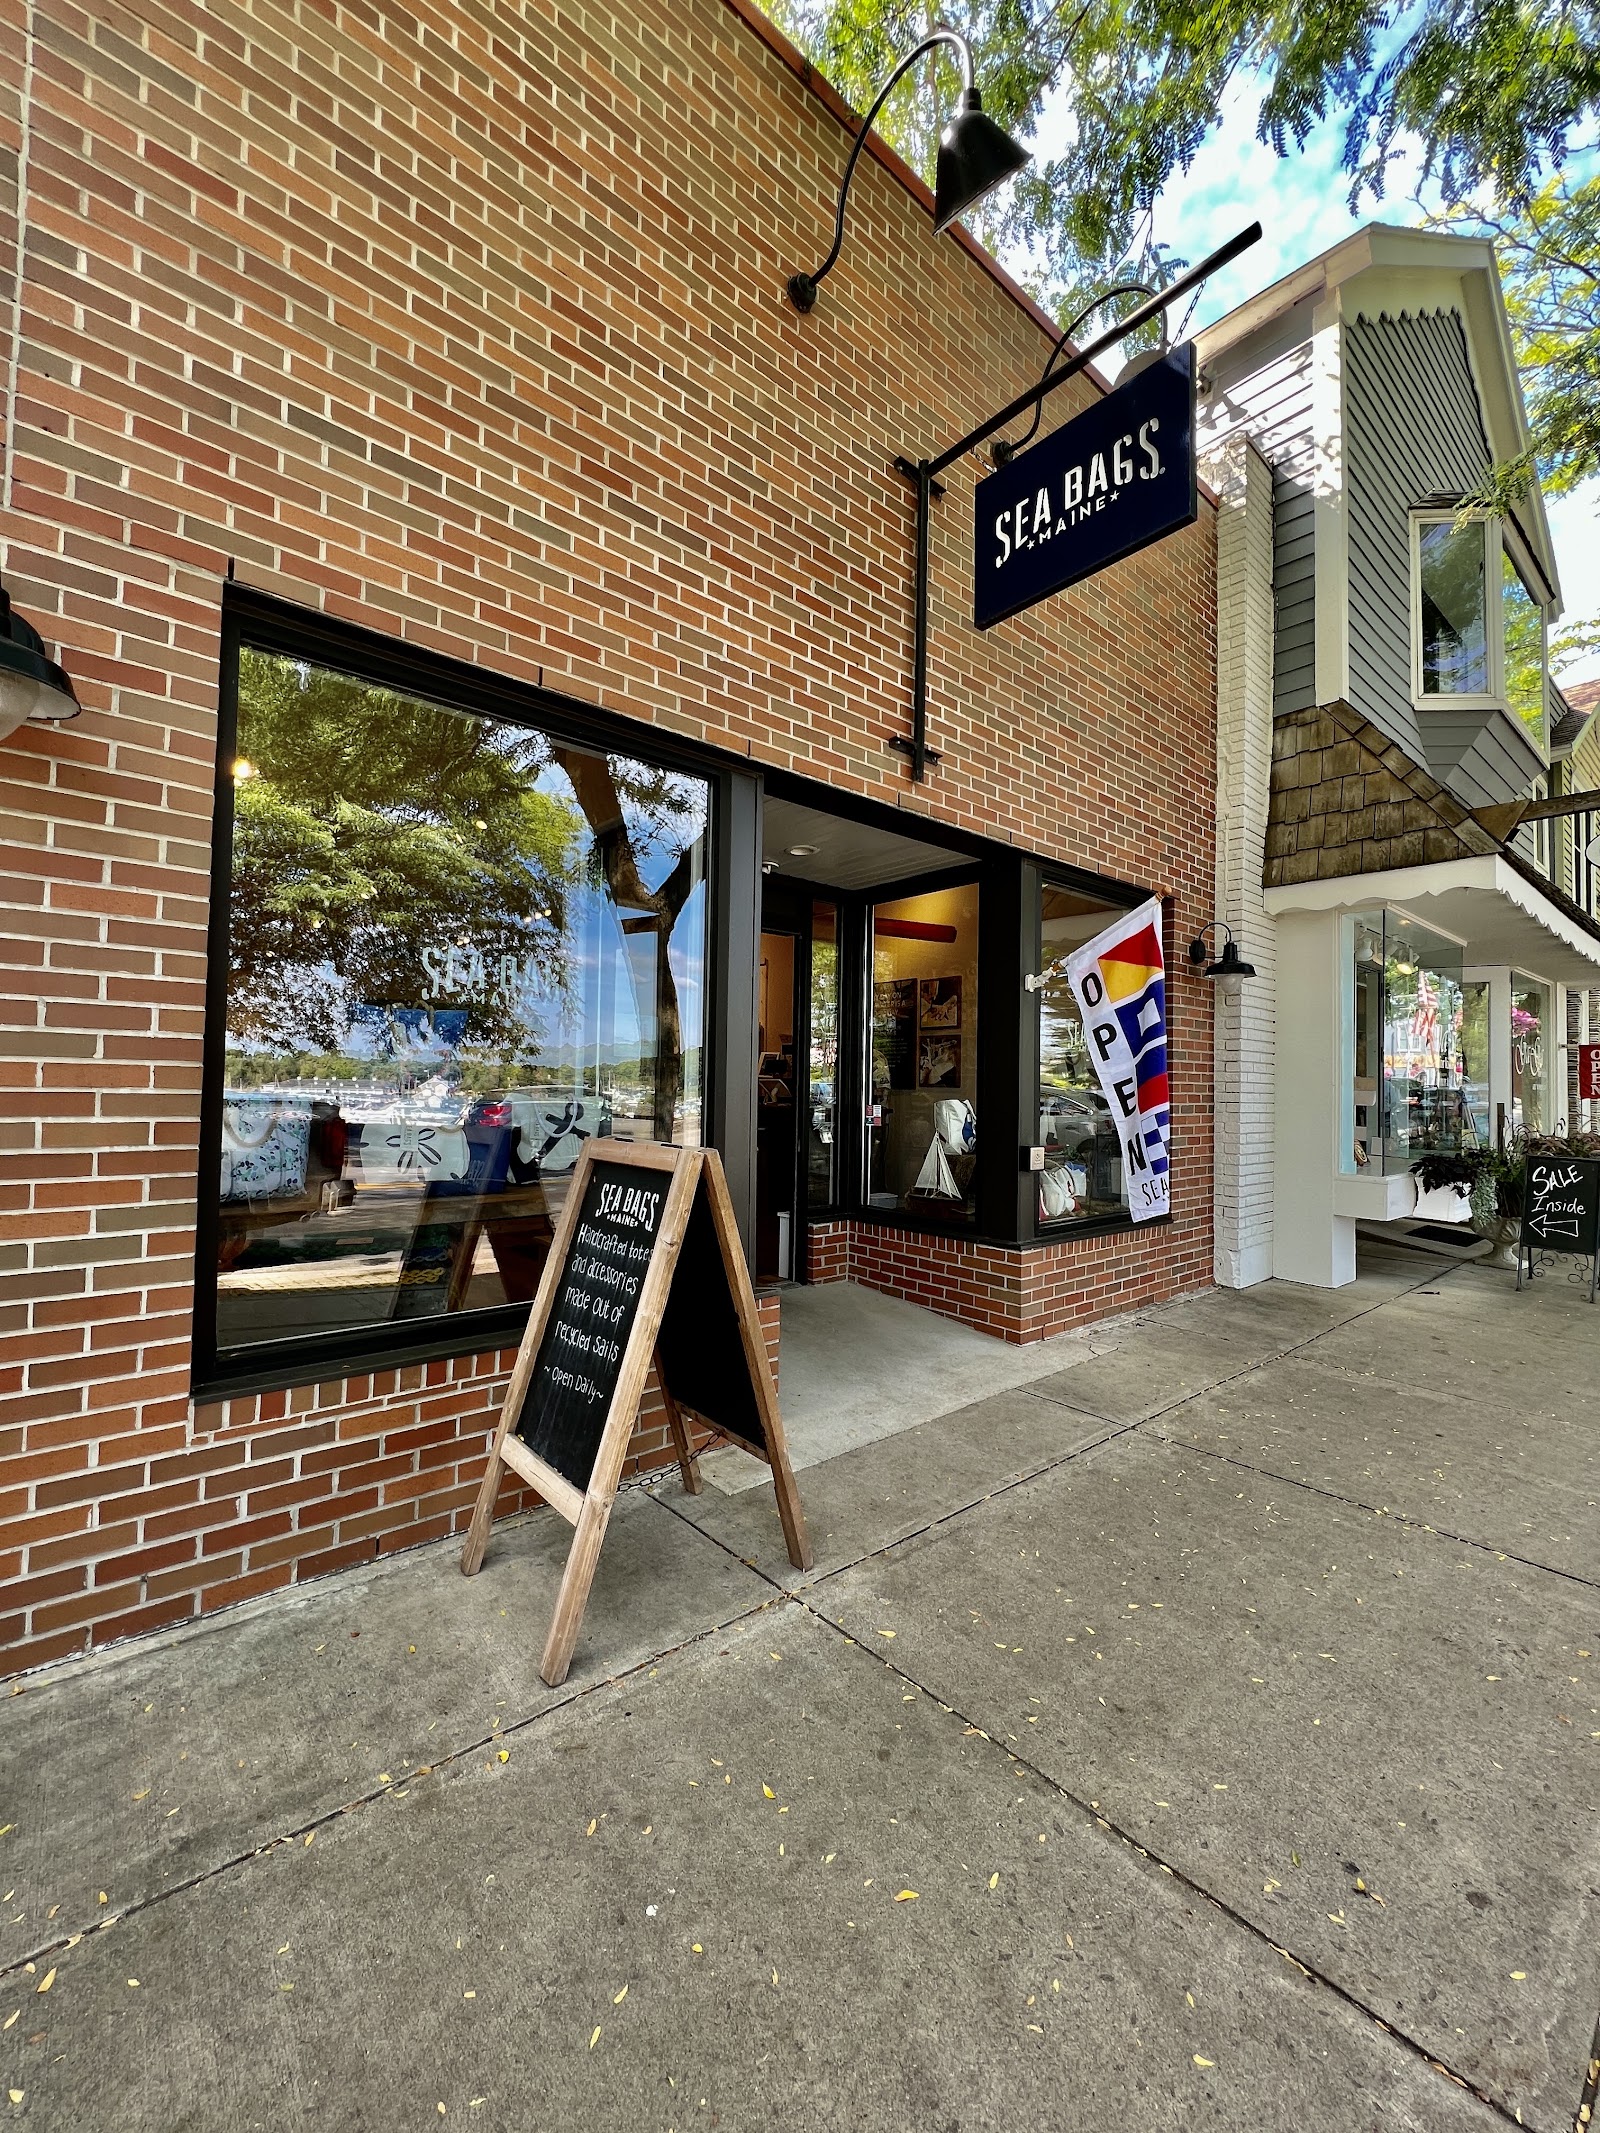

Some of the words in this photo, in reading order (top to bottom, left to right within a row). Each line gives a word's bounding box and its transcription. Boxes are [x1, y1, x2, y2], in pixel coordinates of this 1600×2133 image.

[995, 487, 1051, 569] SEA
[1064, 417, 1160, 510] BAGS
[1039, 495, 1106, 544] MAINE
[422, 946, 485, 1000] SEA
[1081, 971, 1148, 1176] OPEN
[1141, 1177, 1170, 1207] SEA
[1532, 1164, 1584, 1196] SALE
[595, 1183, 623, 1217] SEA
[622, 1187, 660, 1232] BAGS
[609, 1213, 637, 1227] MAINE
[1531, 1195, 1587, 1215] Inside
[577, 1223, 628, 1256] Handcrafted
[571, 1253, 588, 1274] and
[587, 1257, 639, 1295] accessories
[564, 1286, 591, 1310] made
[592, 1297, 610, 1320] out
[610, 1305, 625, 1324] of
[555, 1321, 591, 1351] recycled
[551, 1366, 574, 1391] Open
